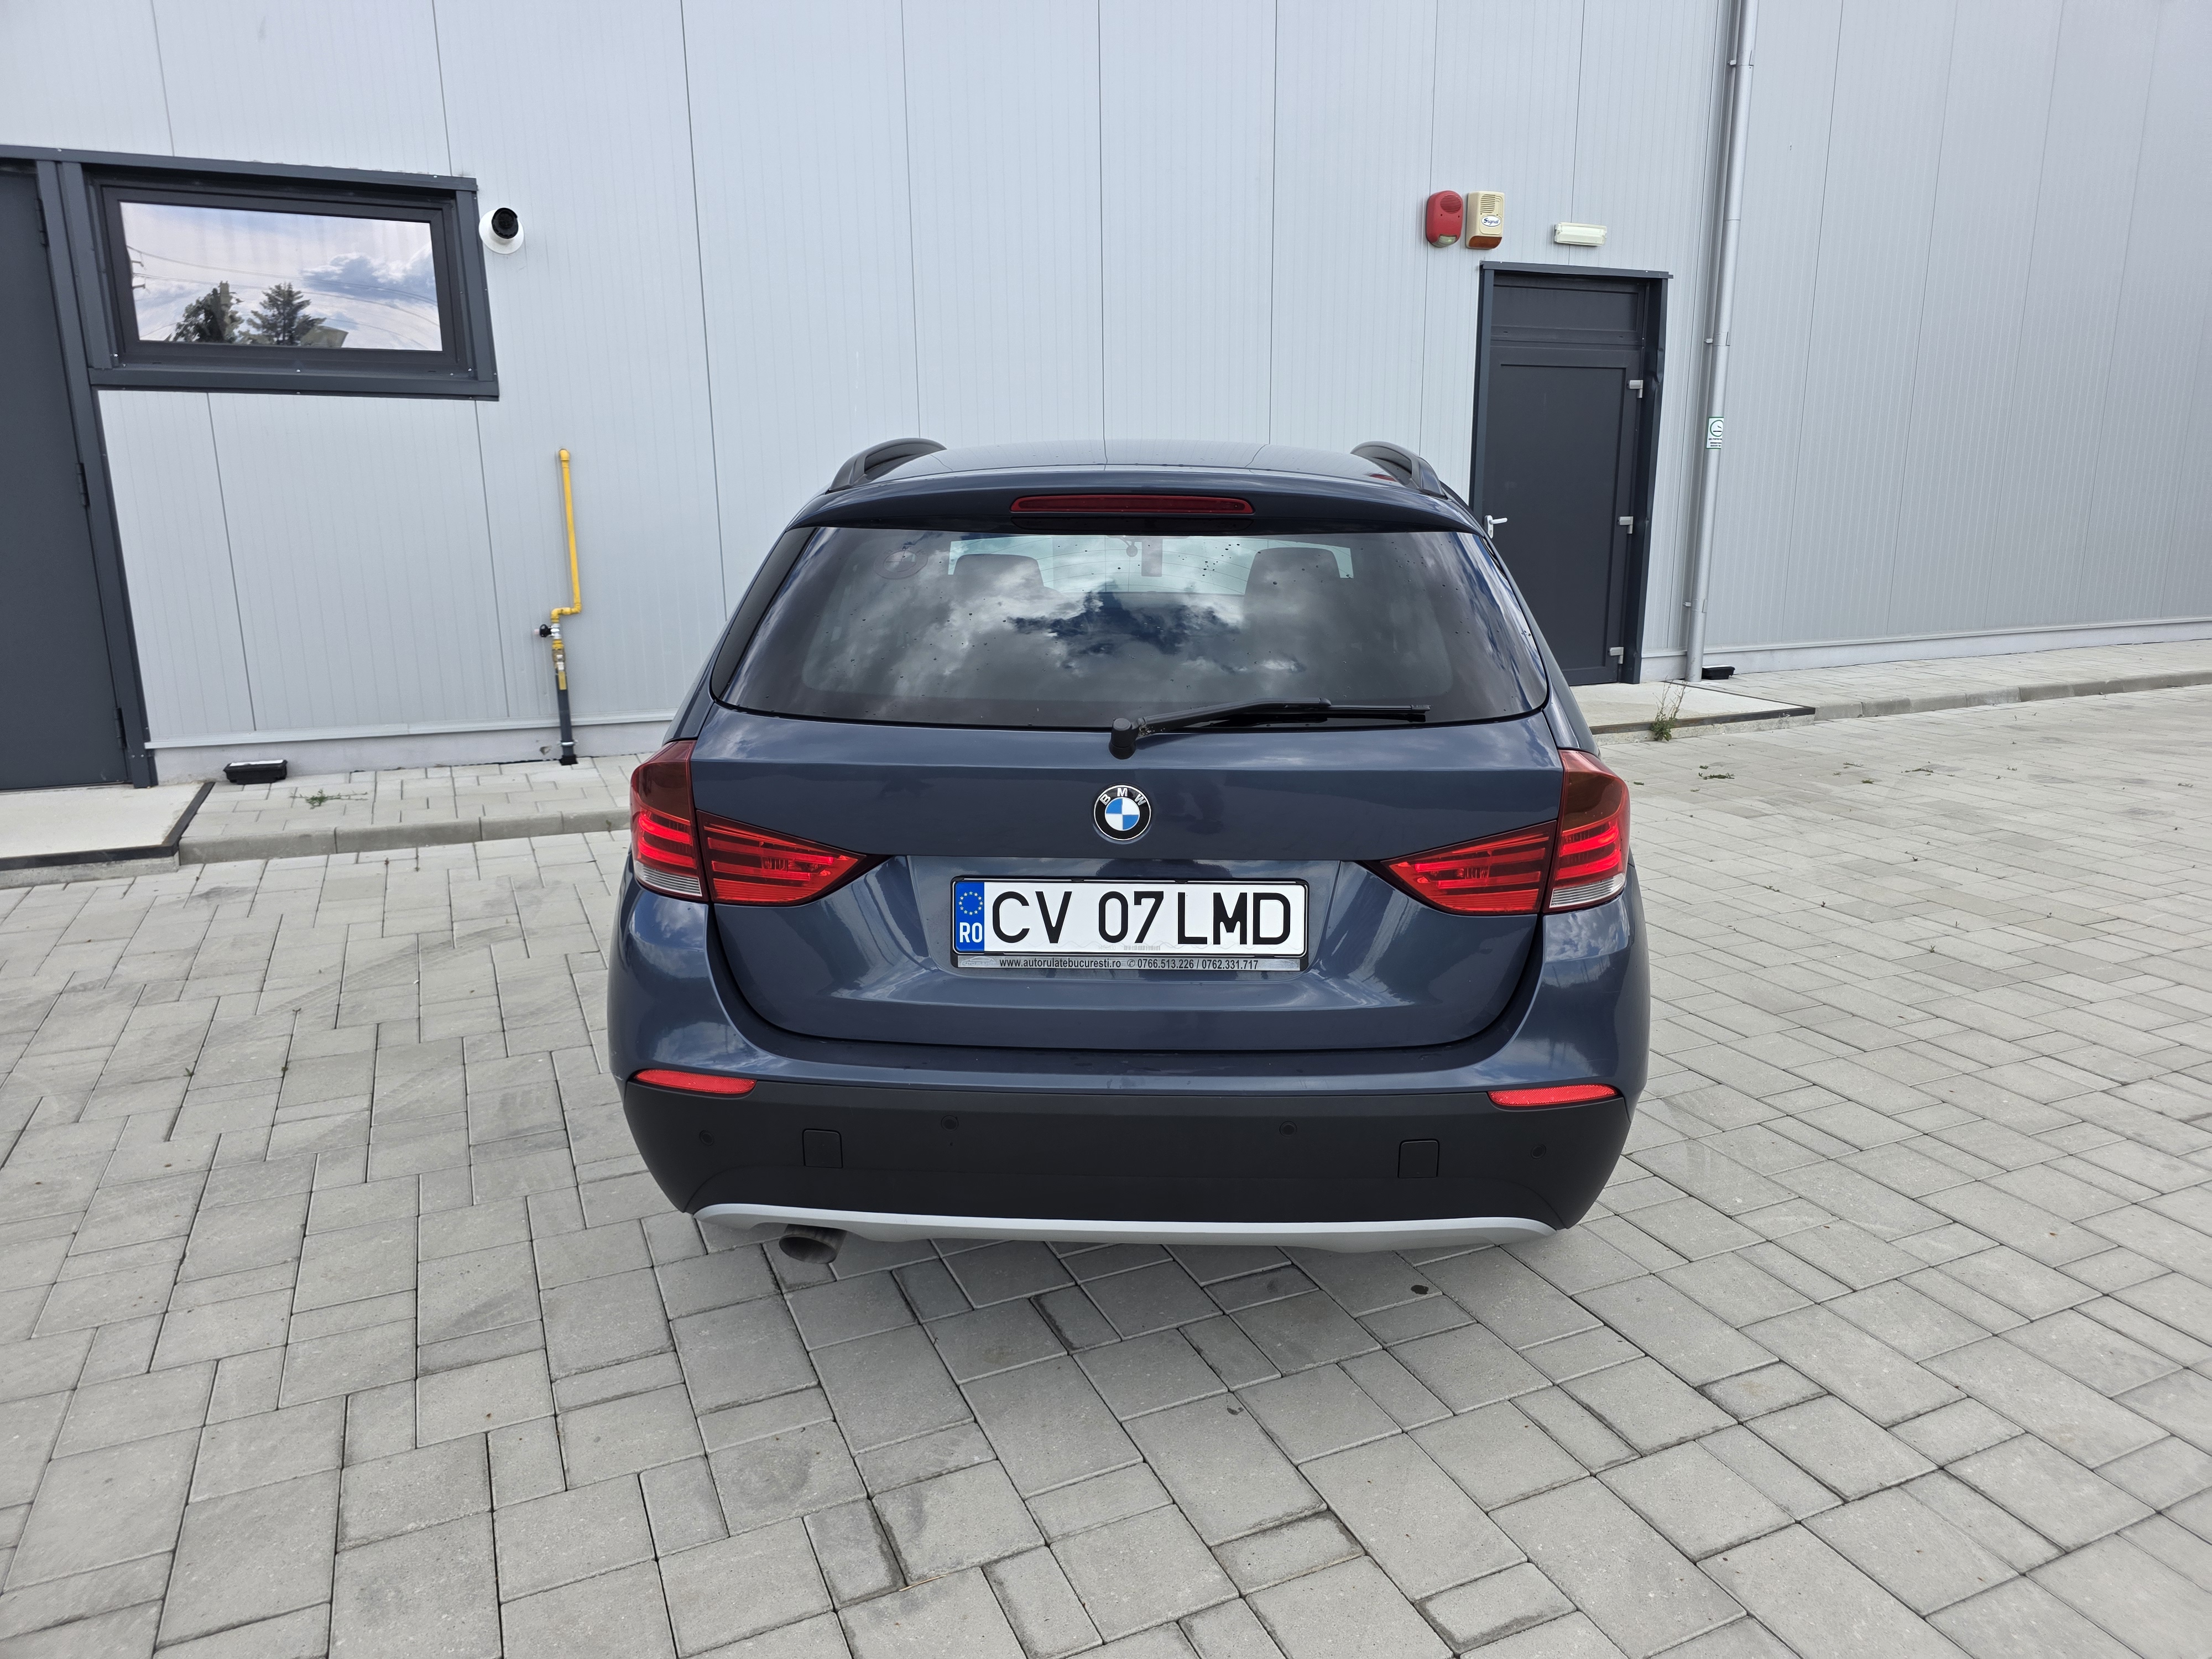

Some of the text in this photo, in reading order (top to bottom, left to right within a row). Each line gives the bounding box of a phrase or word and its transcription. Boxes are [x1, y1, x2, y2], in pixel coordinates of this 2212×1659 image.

[1100, 788, 1146, 805] BMW
[992, 891, 1290, 945] CV 07 LMD
[960, 922, 982, 942] RO
[999, 958, 1121, 968] www.autorulatebucuresti.ro
[1138, 959, 1194, 969] 0766.513.226
[1202, 959, 1259, 969] 0762.331.717
